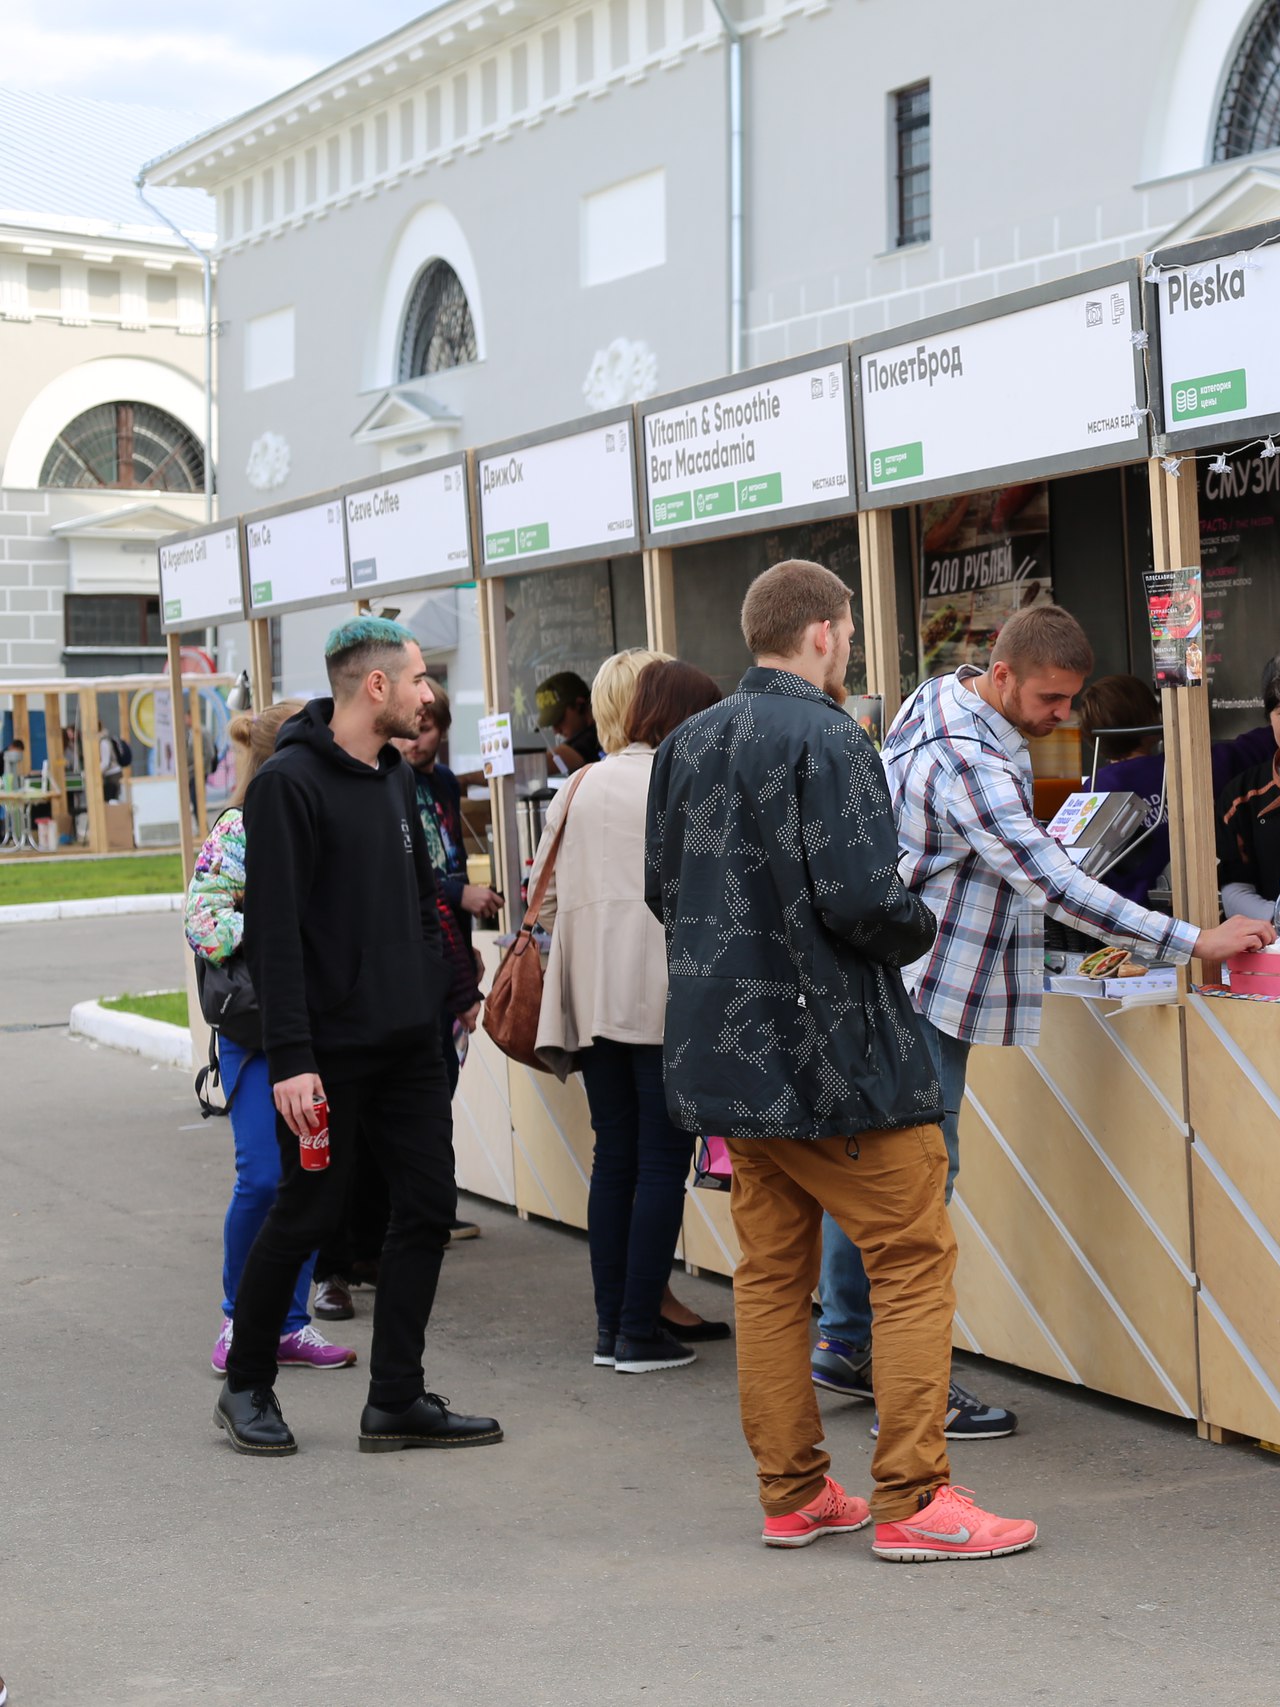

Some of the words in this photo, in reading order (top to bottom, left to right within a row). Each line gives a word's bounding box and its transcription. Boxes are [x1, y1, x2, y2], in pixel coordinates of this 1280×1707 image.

[1167, 263, 1246, 315] Pleska
[867, 344, 963, 393] ПокетБрод
[1200, 381, 1232, 394] категория
[648, 410, 697, 448] Vitamin
[701, 405, 711, 435] &
[713, 388, 781, 433] Smoothie
[1200, 397, 1217, 409] цены
[1087, 416, 1119, 435] МЕСТНАЯ
[1121, 413, 1135, 428] ЕДА
[483, 457, 524, 494] ДвижОк
[651, 455, 673, 484] Bar
[675, 433, 756, 478] Macadamia
[1205, 455, 1280, 500] СМУЗИ
[812, 477, 836, 490] МЕСТНАЯ
[836, 474, 847, 487] ЕДА
[348, 499, 372, 523] Cezve
[373, 491, 400, 517] Coffee
[928, 558, 962, 595] 200
[962, 538, 1013, 590] РУБЛЕЙ
